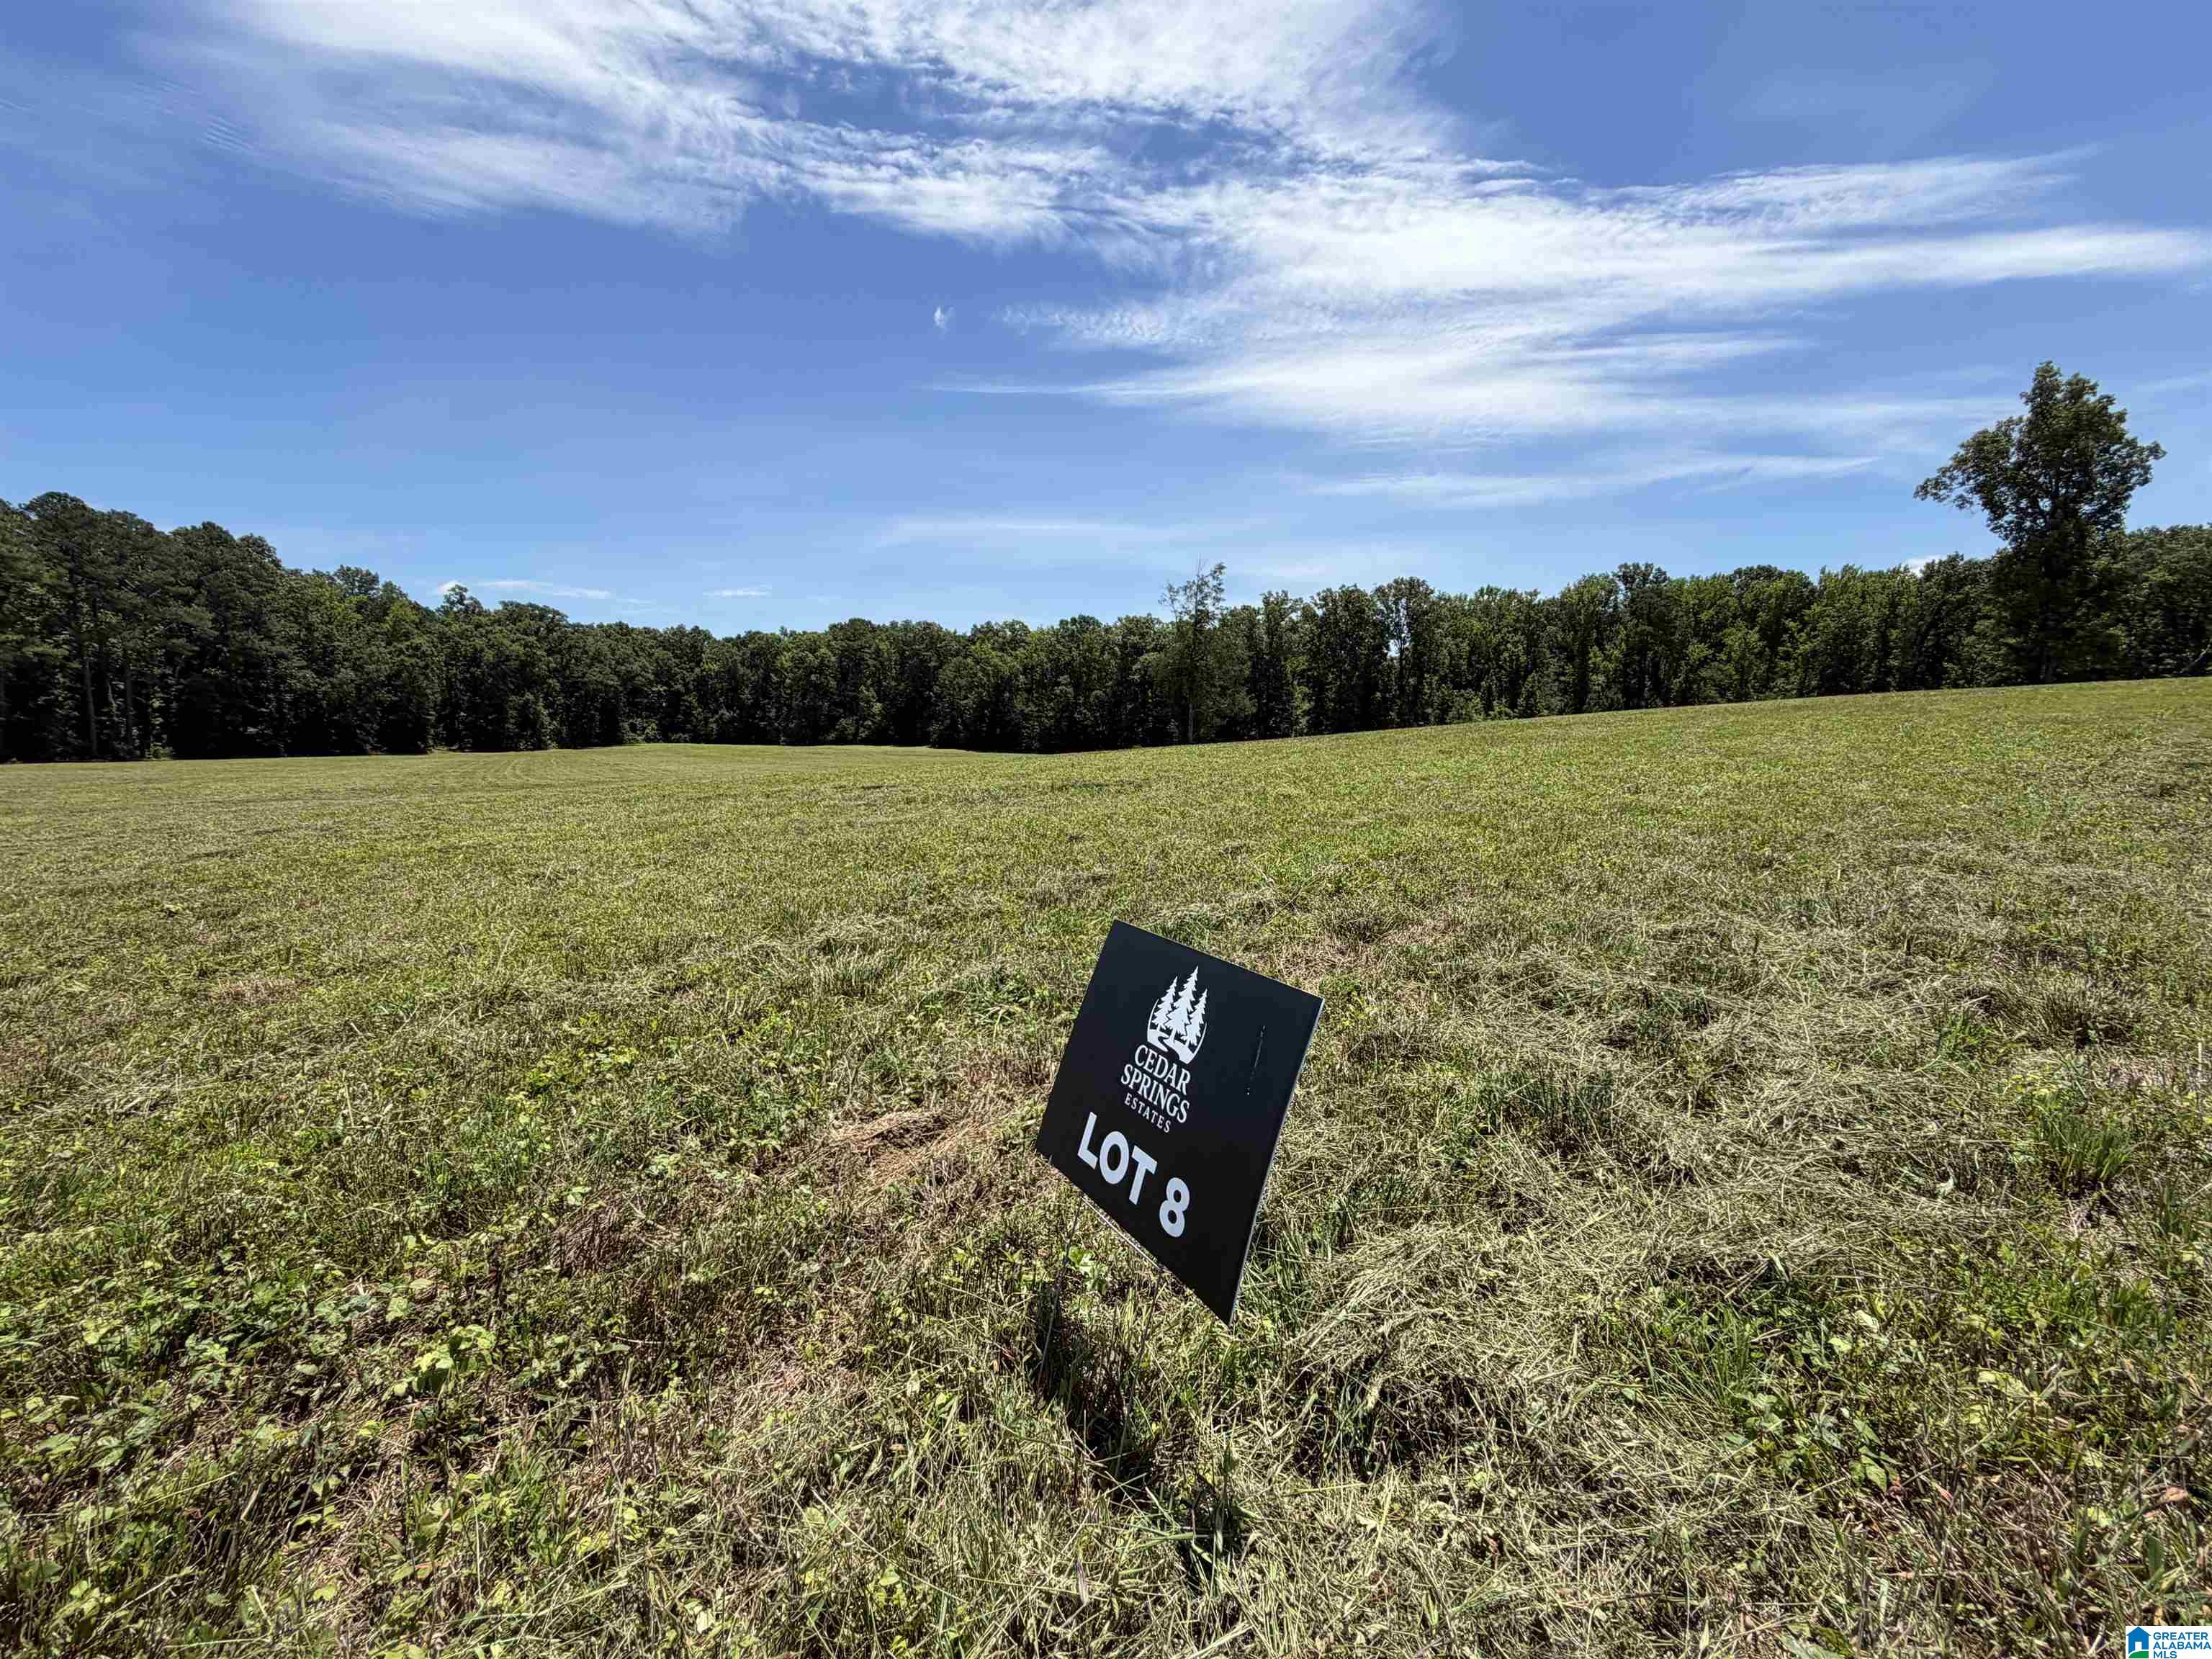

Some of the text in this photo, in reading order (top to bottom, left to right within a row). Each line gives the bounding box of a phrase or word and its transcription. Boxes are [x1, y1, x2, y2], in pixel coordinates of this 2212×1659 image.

[1121, 1064, 1190, 1124] SPRINGS
[1135, 1044, 1191, 1093] CEDAR
[1124, 1092, 1171, 1133] ESTATES
[1077, 1112, 1190, 1238] LOT 8
